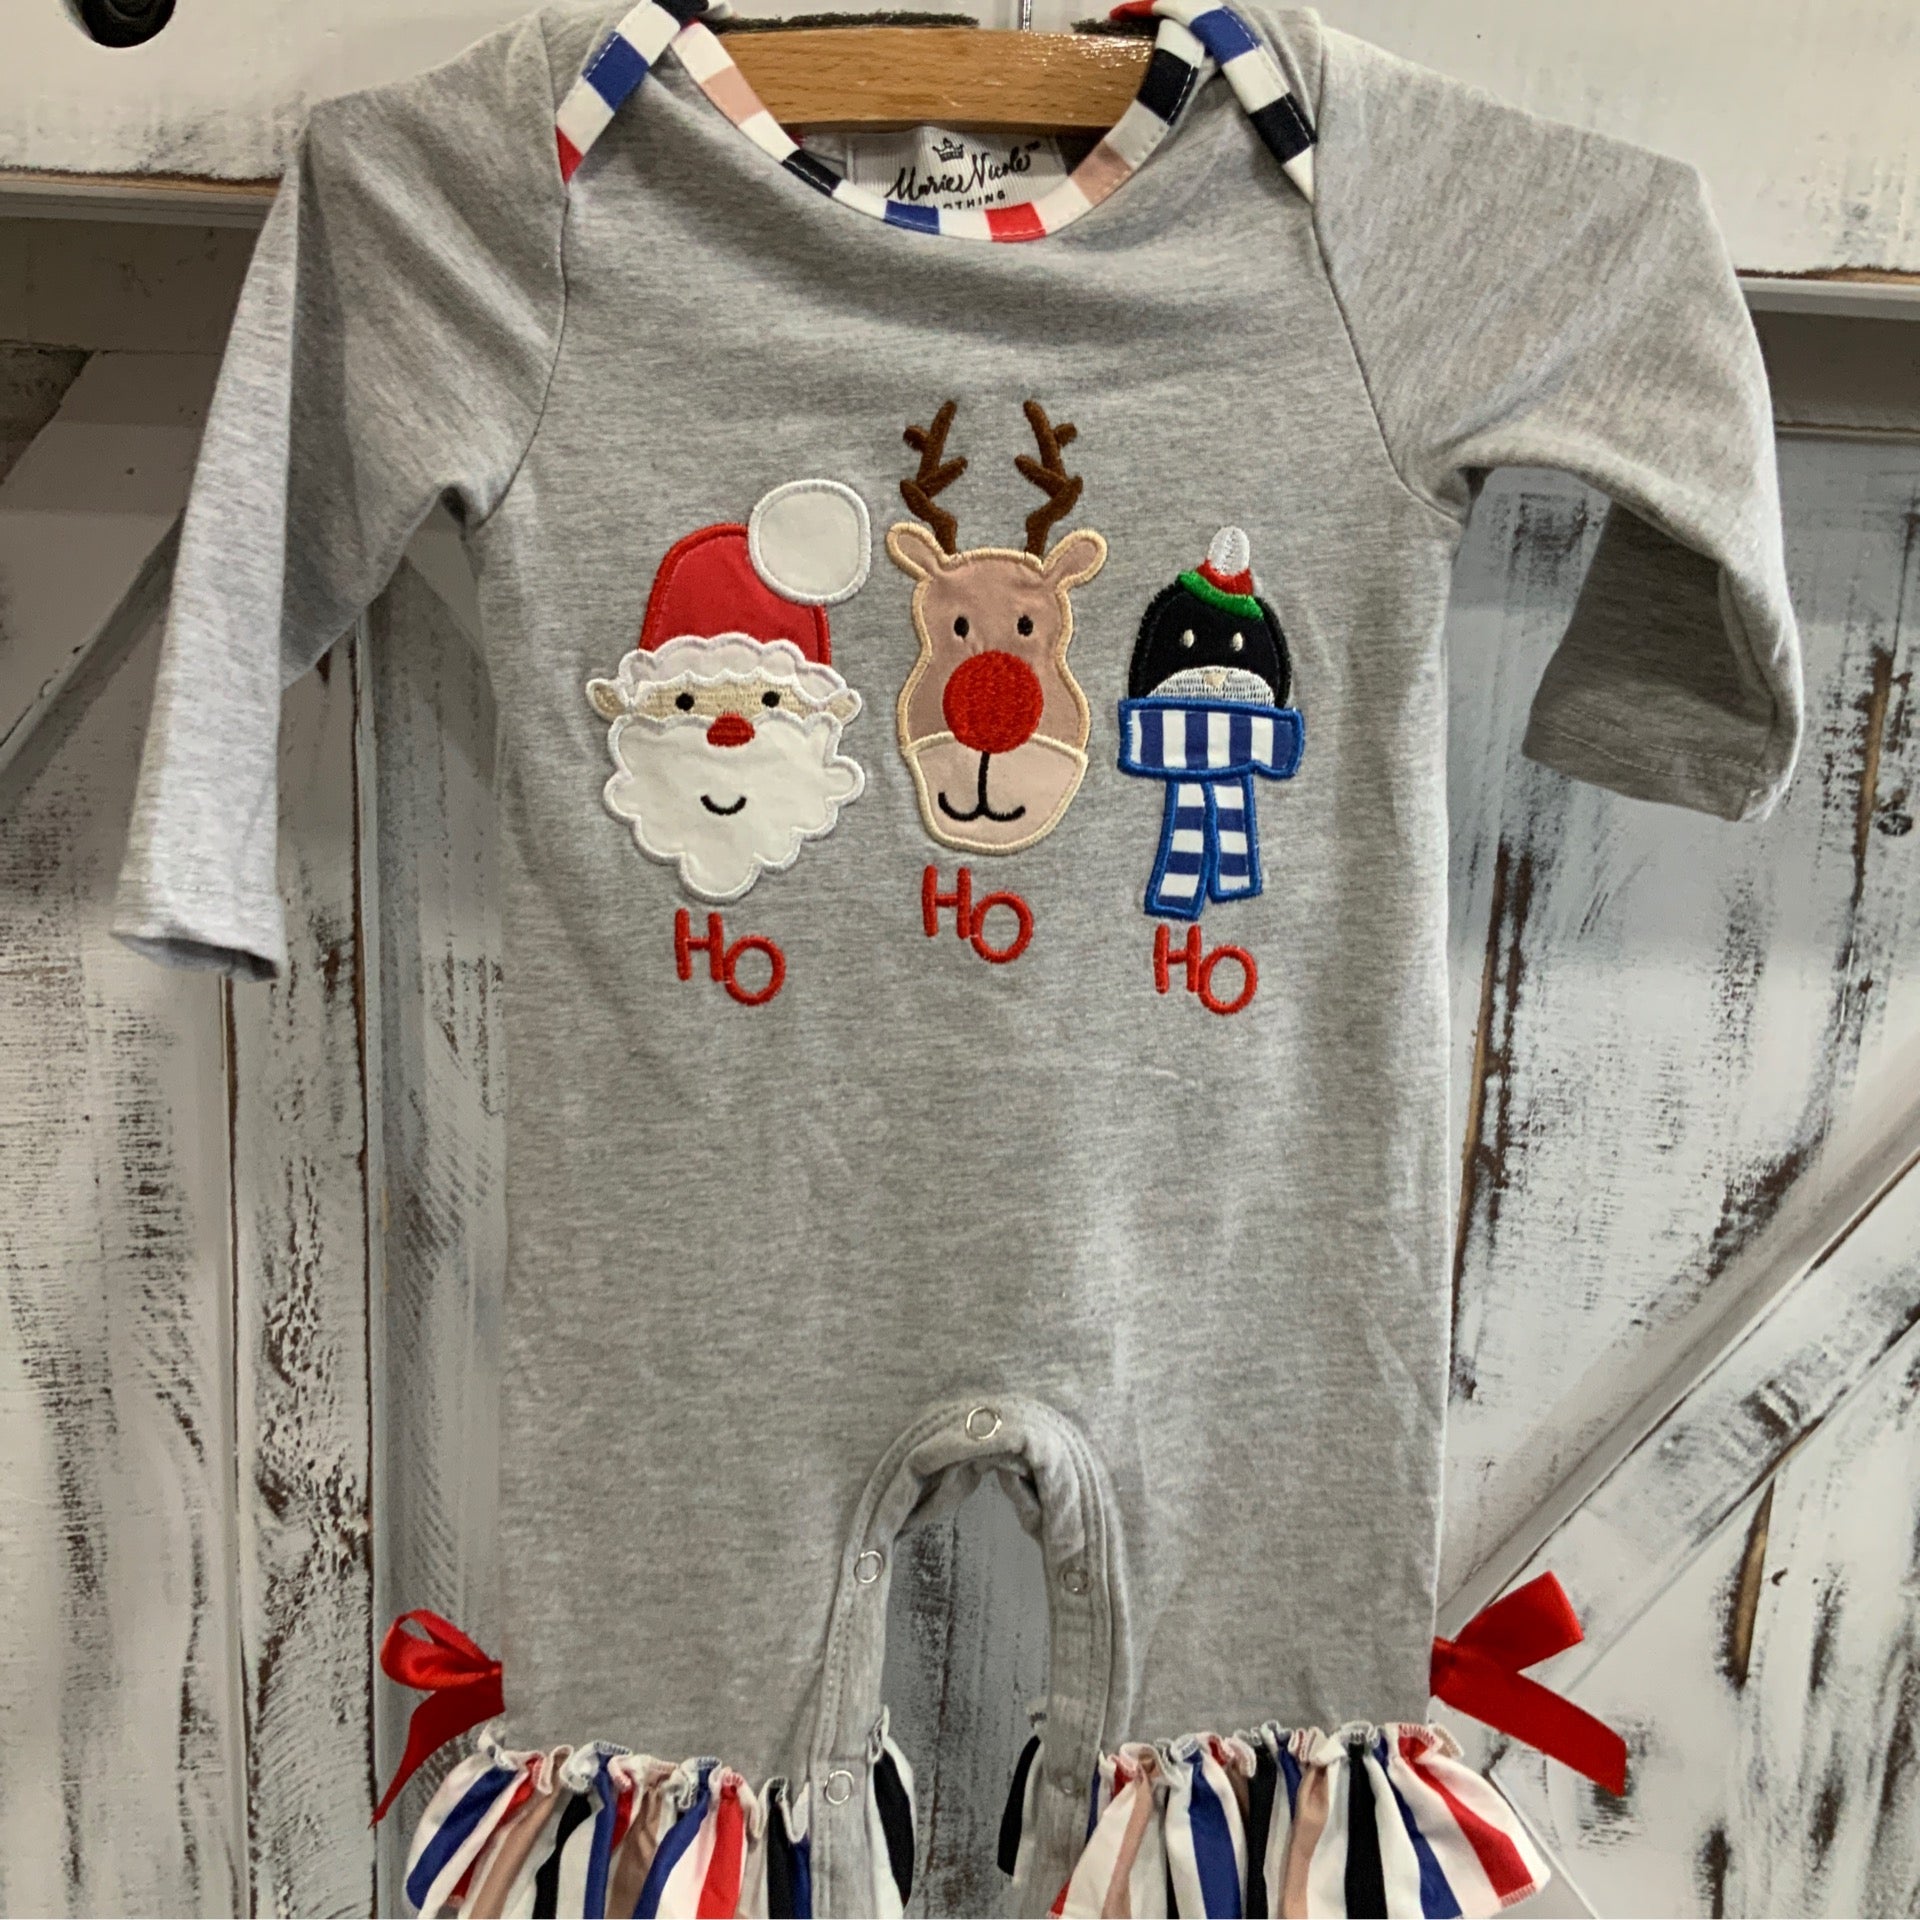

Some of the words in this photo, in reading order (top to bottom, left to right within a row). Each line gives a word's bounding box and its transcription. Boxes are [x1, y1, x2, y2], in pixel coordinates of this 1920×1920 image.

[674, 908, 786, 1006] HO
[921, 864, 1034, 964] HO
[1153, 923, 1258, 1015] HO
